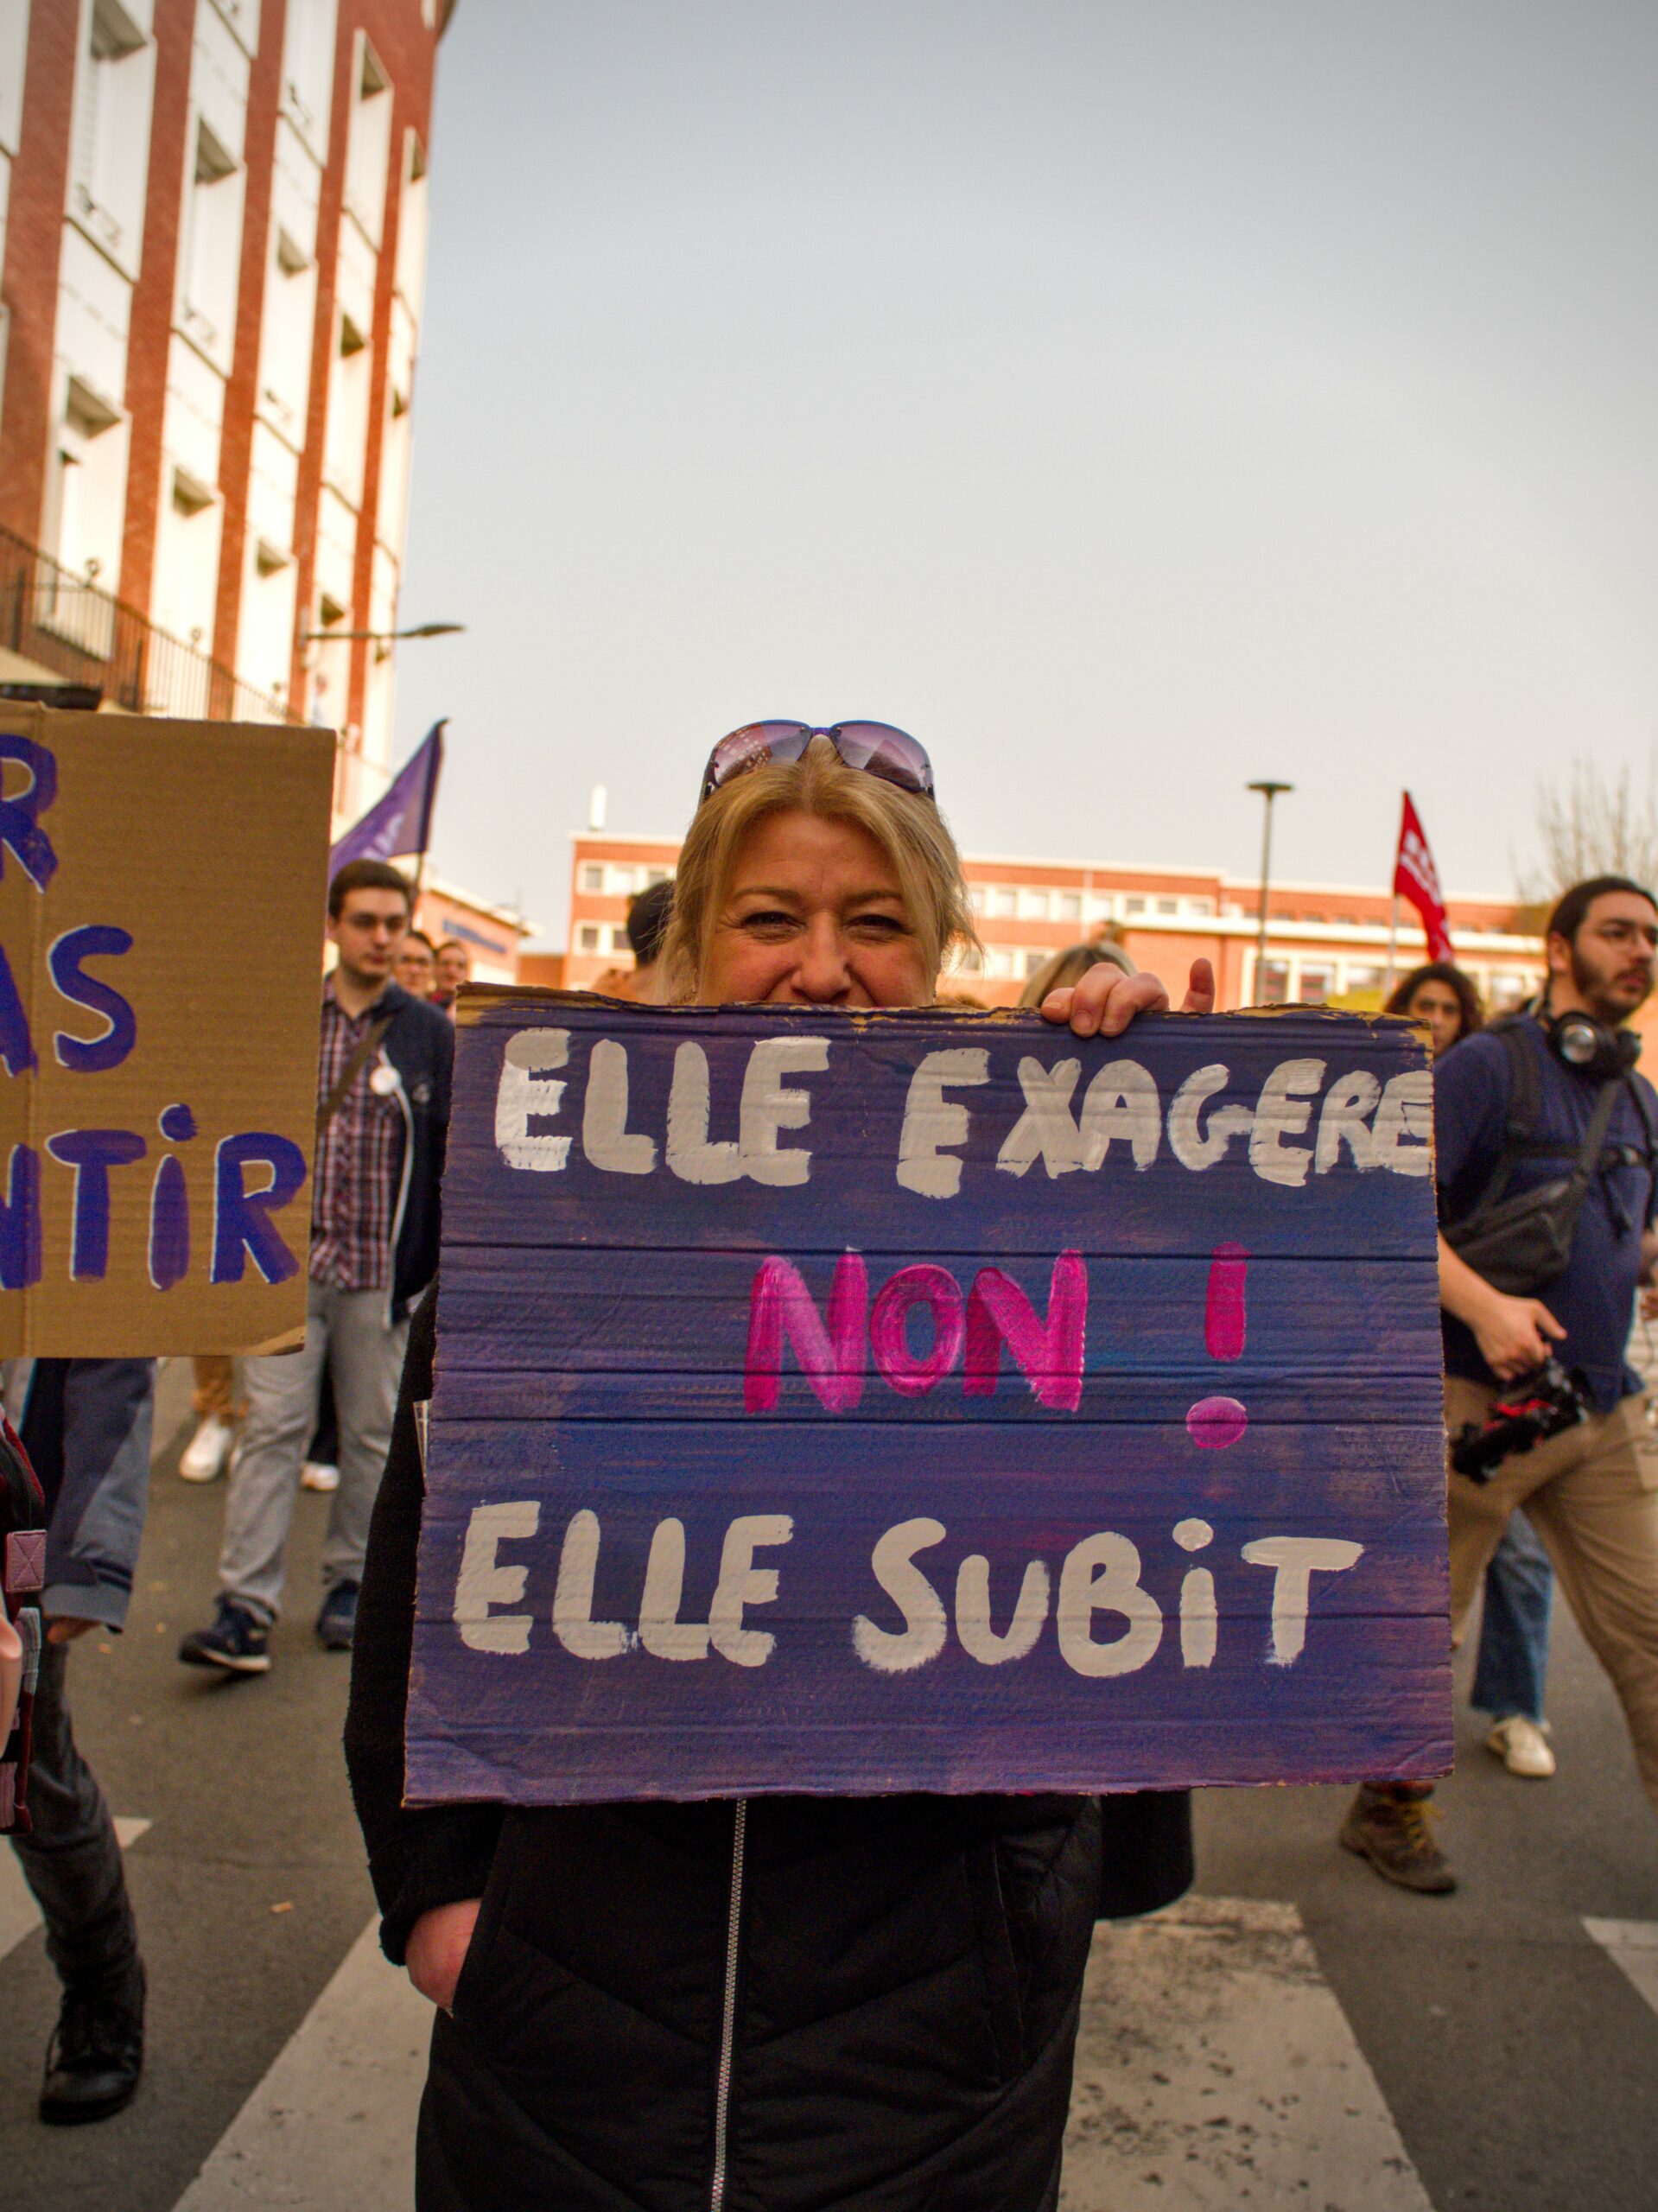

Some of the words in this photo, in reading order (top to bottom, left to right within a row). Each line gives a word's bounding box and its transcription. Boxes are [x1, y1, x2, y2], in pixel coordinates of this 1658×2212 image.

[494, 1027, 833, 1186] ELLE
[896, 1047, 1434, 1199] EXAGERE
[744, 1246, 1089, 1415] NON
[1185, 1242, 1251, 1449] !
[452, 1500, 796, 1667] ELLE
